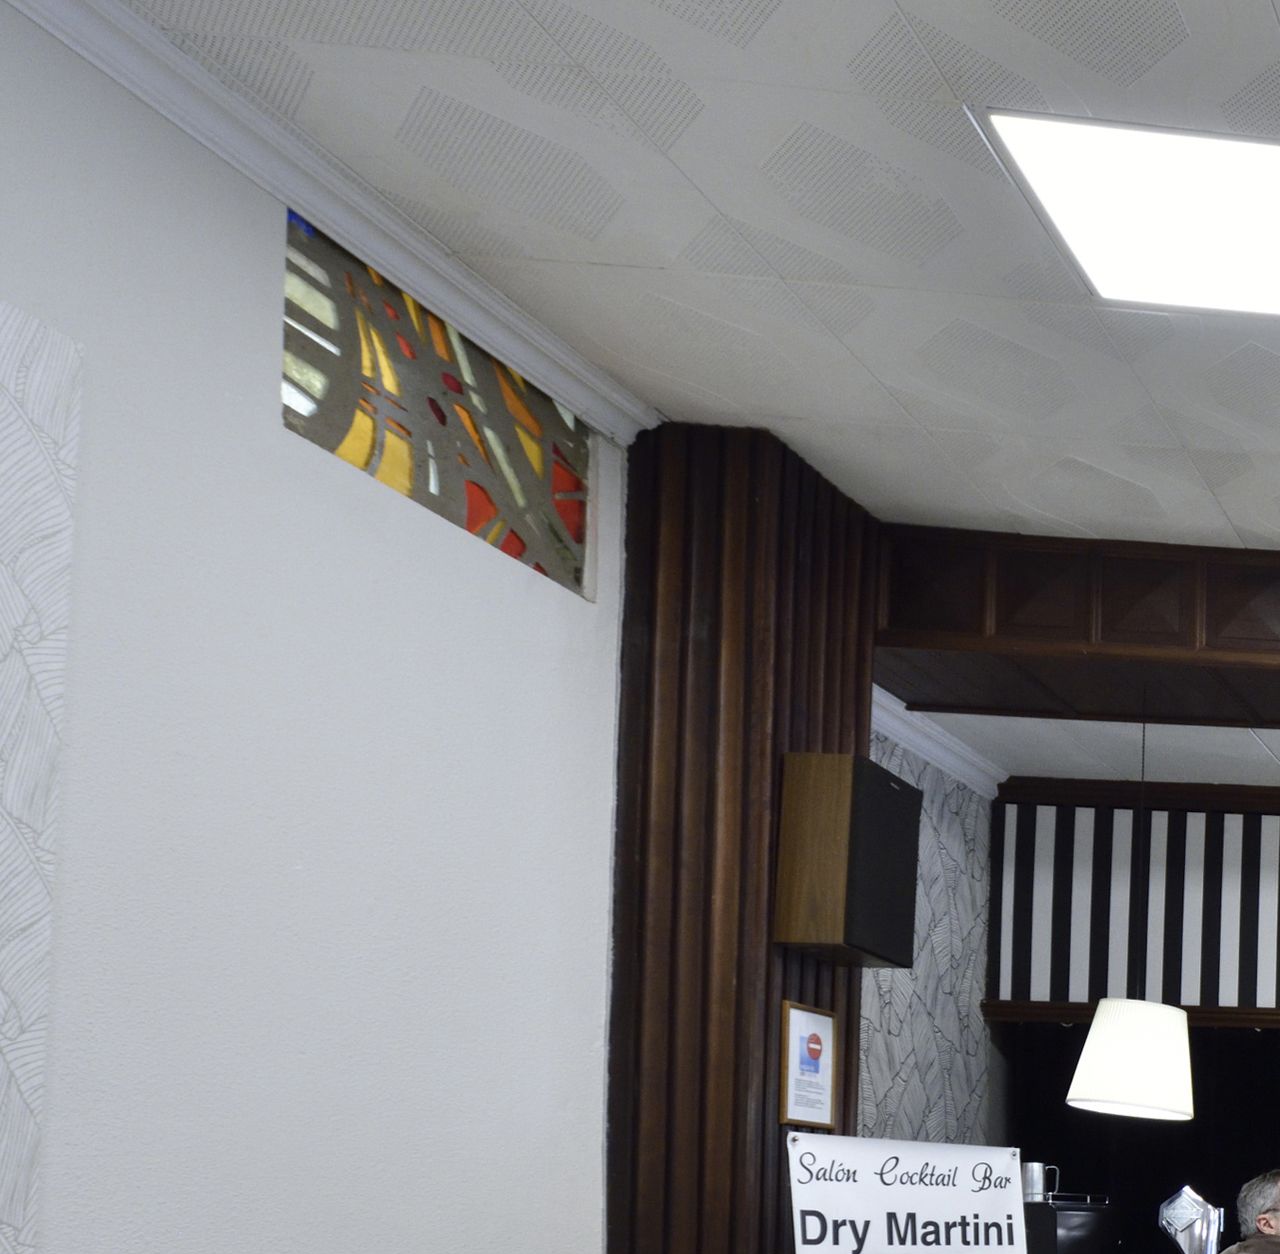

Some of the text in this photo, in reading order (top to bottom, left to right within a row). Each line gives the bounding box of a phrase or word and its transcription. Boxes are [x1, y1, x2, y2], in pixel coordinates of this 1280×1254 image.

[797, 1152, 1012, 1193] Salón Cocktail Bar
[886, 1211, 1015, 1246] Martini
